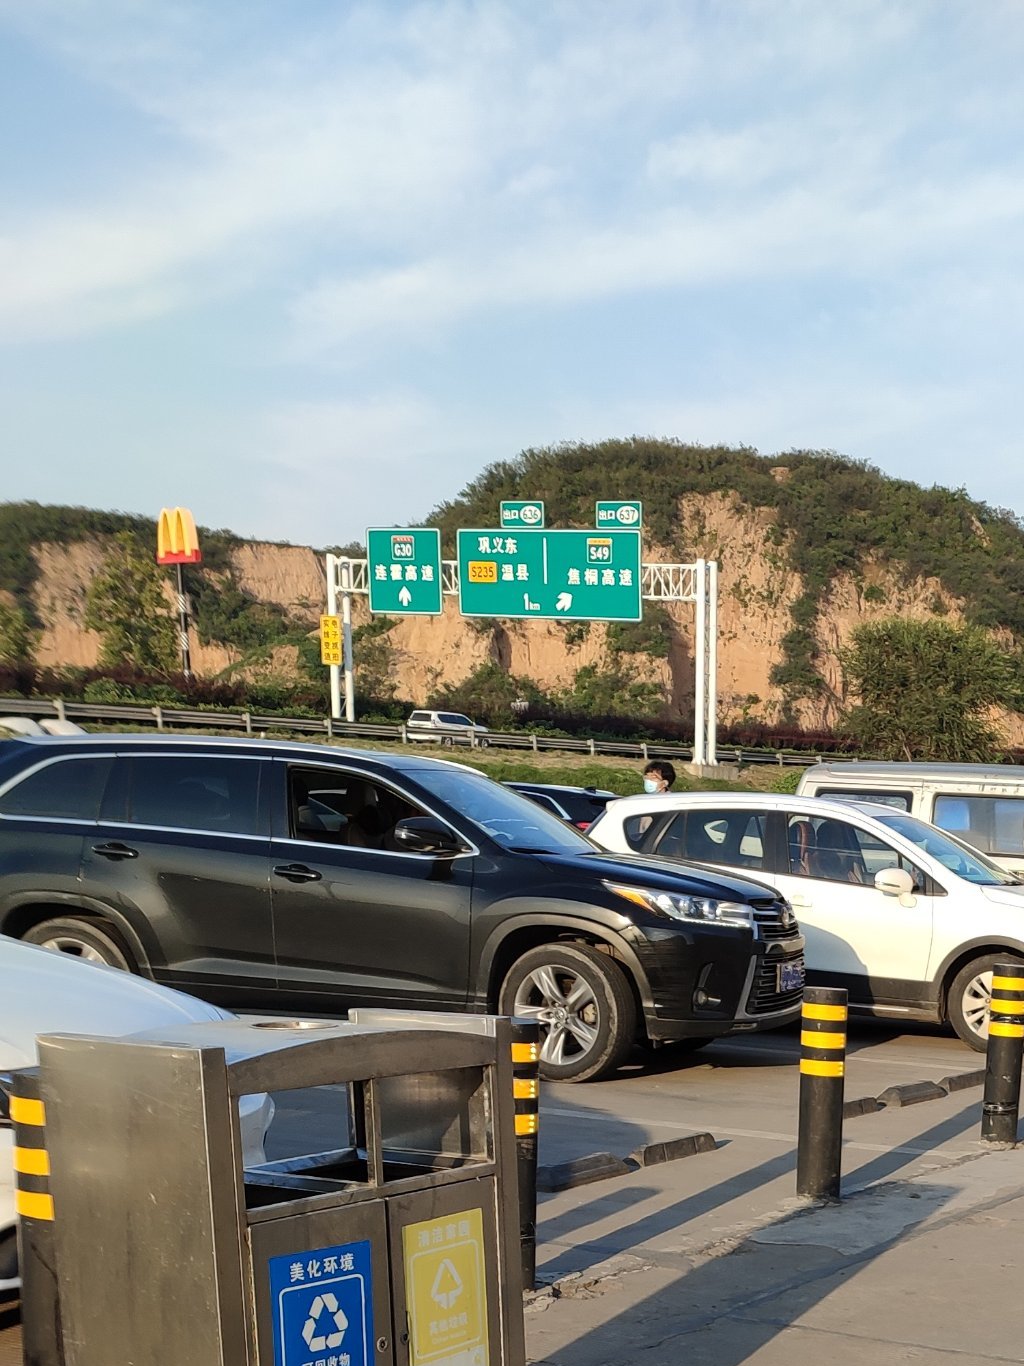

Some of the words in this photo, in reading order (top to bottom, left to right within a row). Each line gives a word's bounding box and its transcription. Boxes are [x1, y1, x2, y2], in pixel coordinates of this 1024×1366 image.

[503, 510, 519, 520] 出口
[522, 509, 539, 520] 636
[599, 510, 615, 520] 出口
[619, 509, 636, 521] 637
[394, 543, 412, 557] G30
[477, 536, 518, 554] 巩义东
[589, 546, 609, 560] S49
[375, 564, 434, 581] 连霍高速
[471, 566, 494, 578] S235
[501, 563, 529, 581] 温县
[567, 567, 633, 586] 焦桐高速
[289, 1252, 355, 1283] 美化环境
